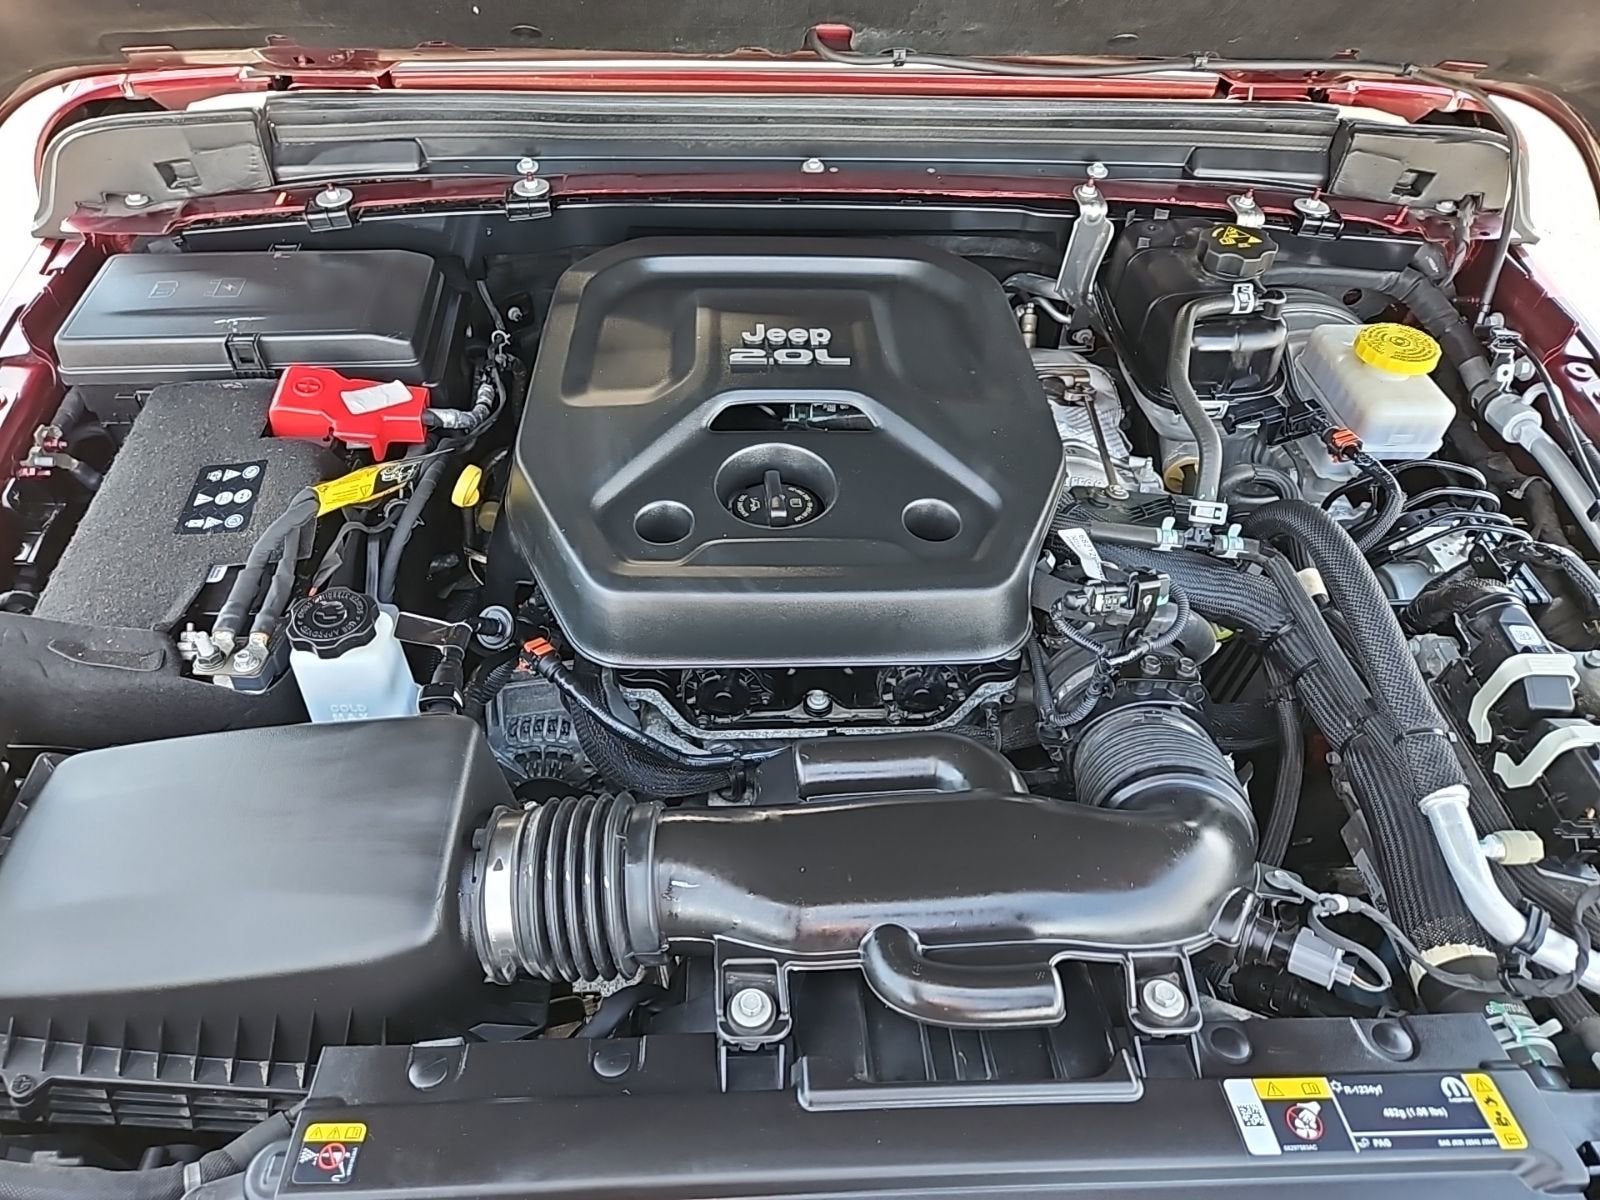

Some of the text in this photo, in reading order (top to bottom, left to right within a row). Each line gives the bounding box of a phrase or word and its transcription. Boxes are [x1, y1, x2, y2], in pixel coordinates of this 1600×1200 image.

[741, 323, 831, 346] Jeep
[729, 348, 850, 365] 2.0L
[299, 620, 357, 638] USE APPROVED
[330, 704, 367, 713] COLD
[1373, 1138, 1392, 1148] PAG
